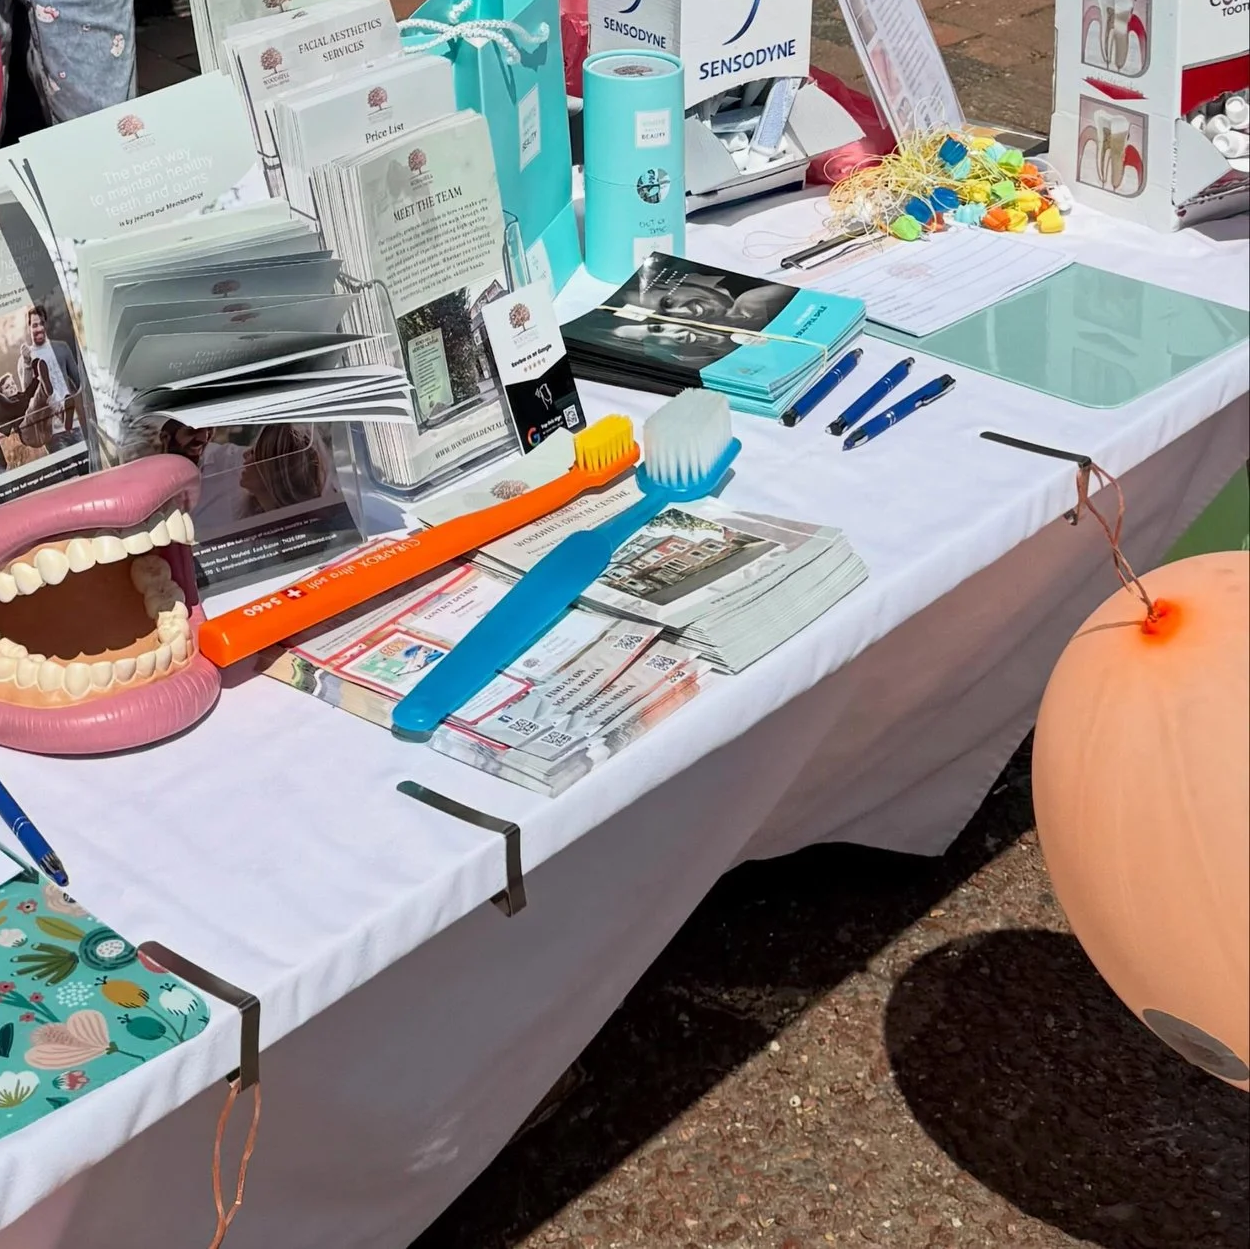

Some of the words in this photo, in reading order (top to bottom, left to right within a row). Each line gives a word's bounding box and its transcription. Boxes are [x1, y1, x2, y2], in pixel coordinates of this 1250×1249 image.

[298, 37, 329, 54] FACIAL
[329, 17, 382, 44] AESTHETICS
[604, 16, 667, 50] SENSODYNE
[322, 40, 365, 62] SERVICES
[699, 39, 796, 81] SENSODYNE
[365, 129, 387, 144] Price
[388, 122, 404, 136] List
[132, 155, 163, 175] best
[107, 173, 164, 200] maintain
[145, 185, 169, 204] and
[393, 204, 415, 223] MEET
[415, 196, 435, 212] THE
[435, 186, 463, 204] TEAM
[359, 538, 421, 568] CURAPROX
[330, 565, 356, 580] ultra
[544, 684, 565, 698] FIND
[564, 676, 574, 687] US
[573, 668, 585, 679] ON
[553, 688, 580, 707] SOCIAL
[578, 668, 605, 688] MEDIA
[585, 701, 611, 719] SOCIAL
[610, 684, 636, 703] MEDIA
